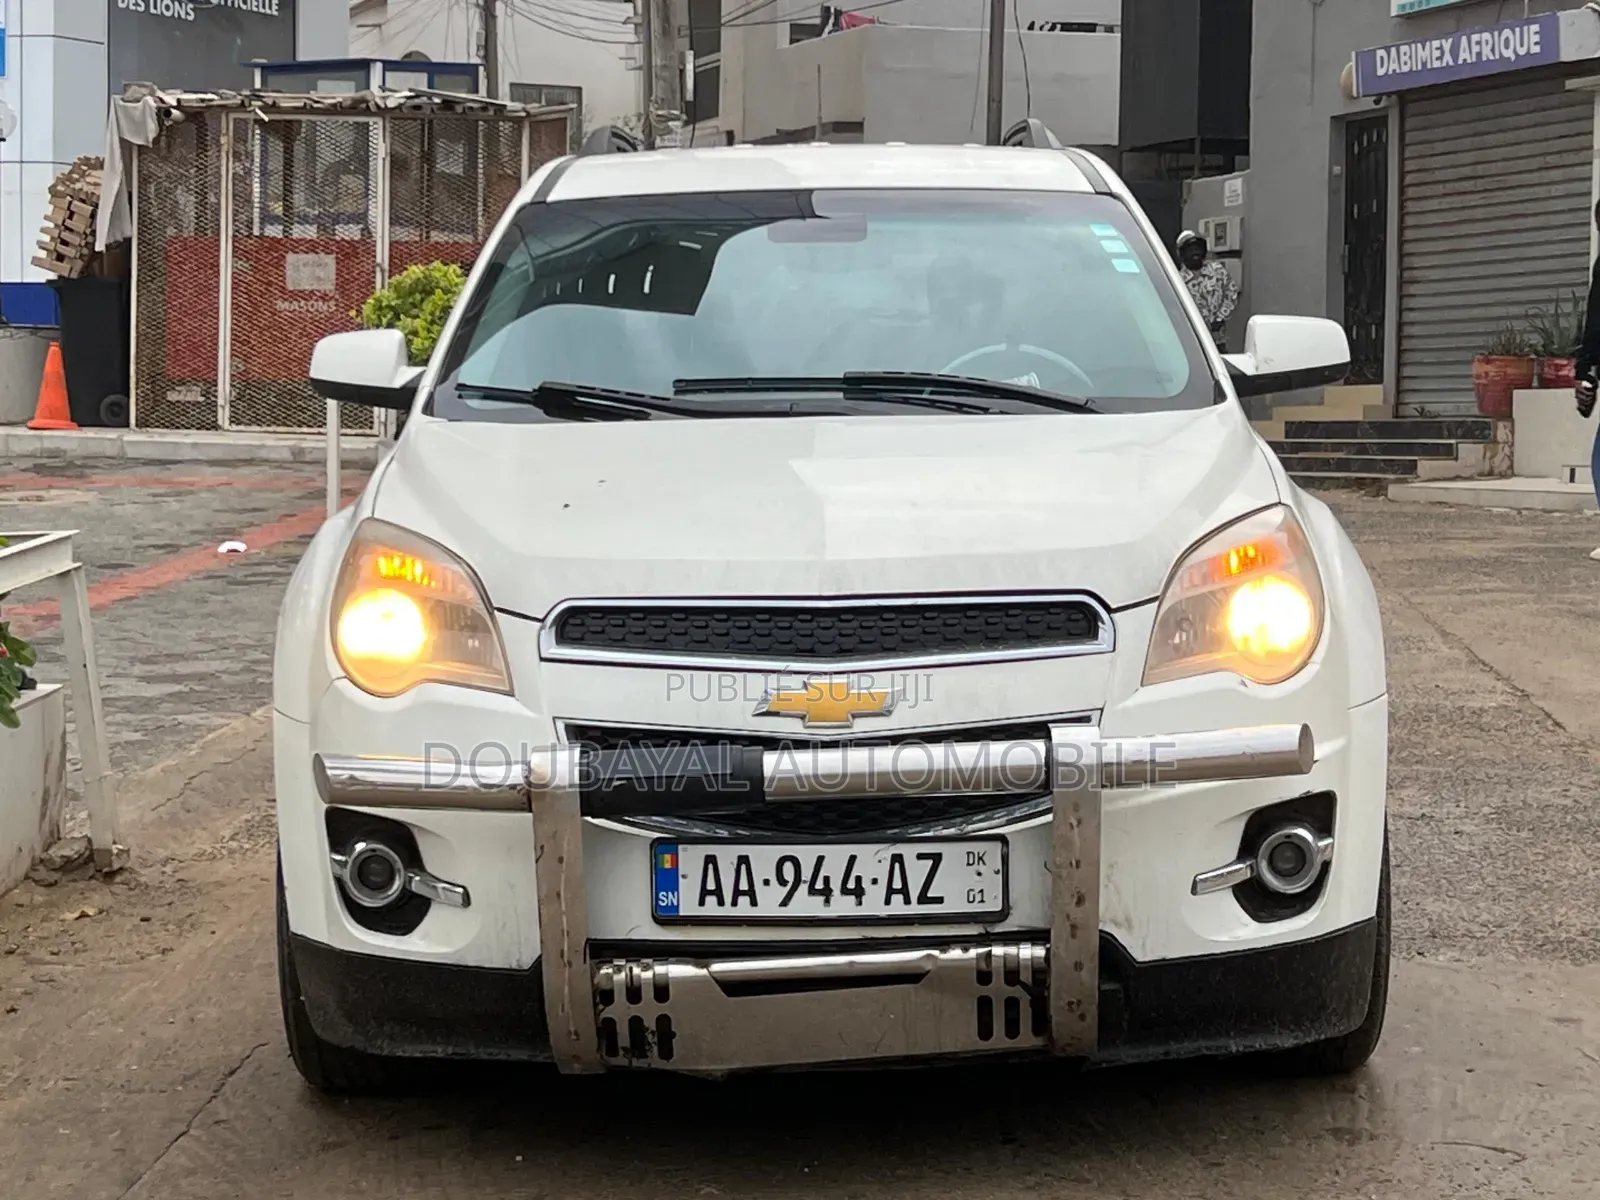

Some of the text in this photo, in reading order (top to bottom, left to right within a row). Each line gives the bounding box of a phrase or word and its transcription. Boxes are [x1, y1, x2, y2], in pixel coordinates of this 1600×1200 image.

[149, 0, 195, 21] LIONS
[209, 0, 279, 16] CIELLE
[1376, 23, 1541, 77] DABIMEX AFRIQUE
[965, 850, 987, 867] DK
[658, 891, 678, 906] SN
[966, 888, 986, 904] 01
